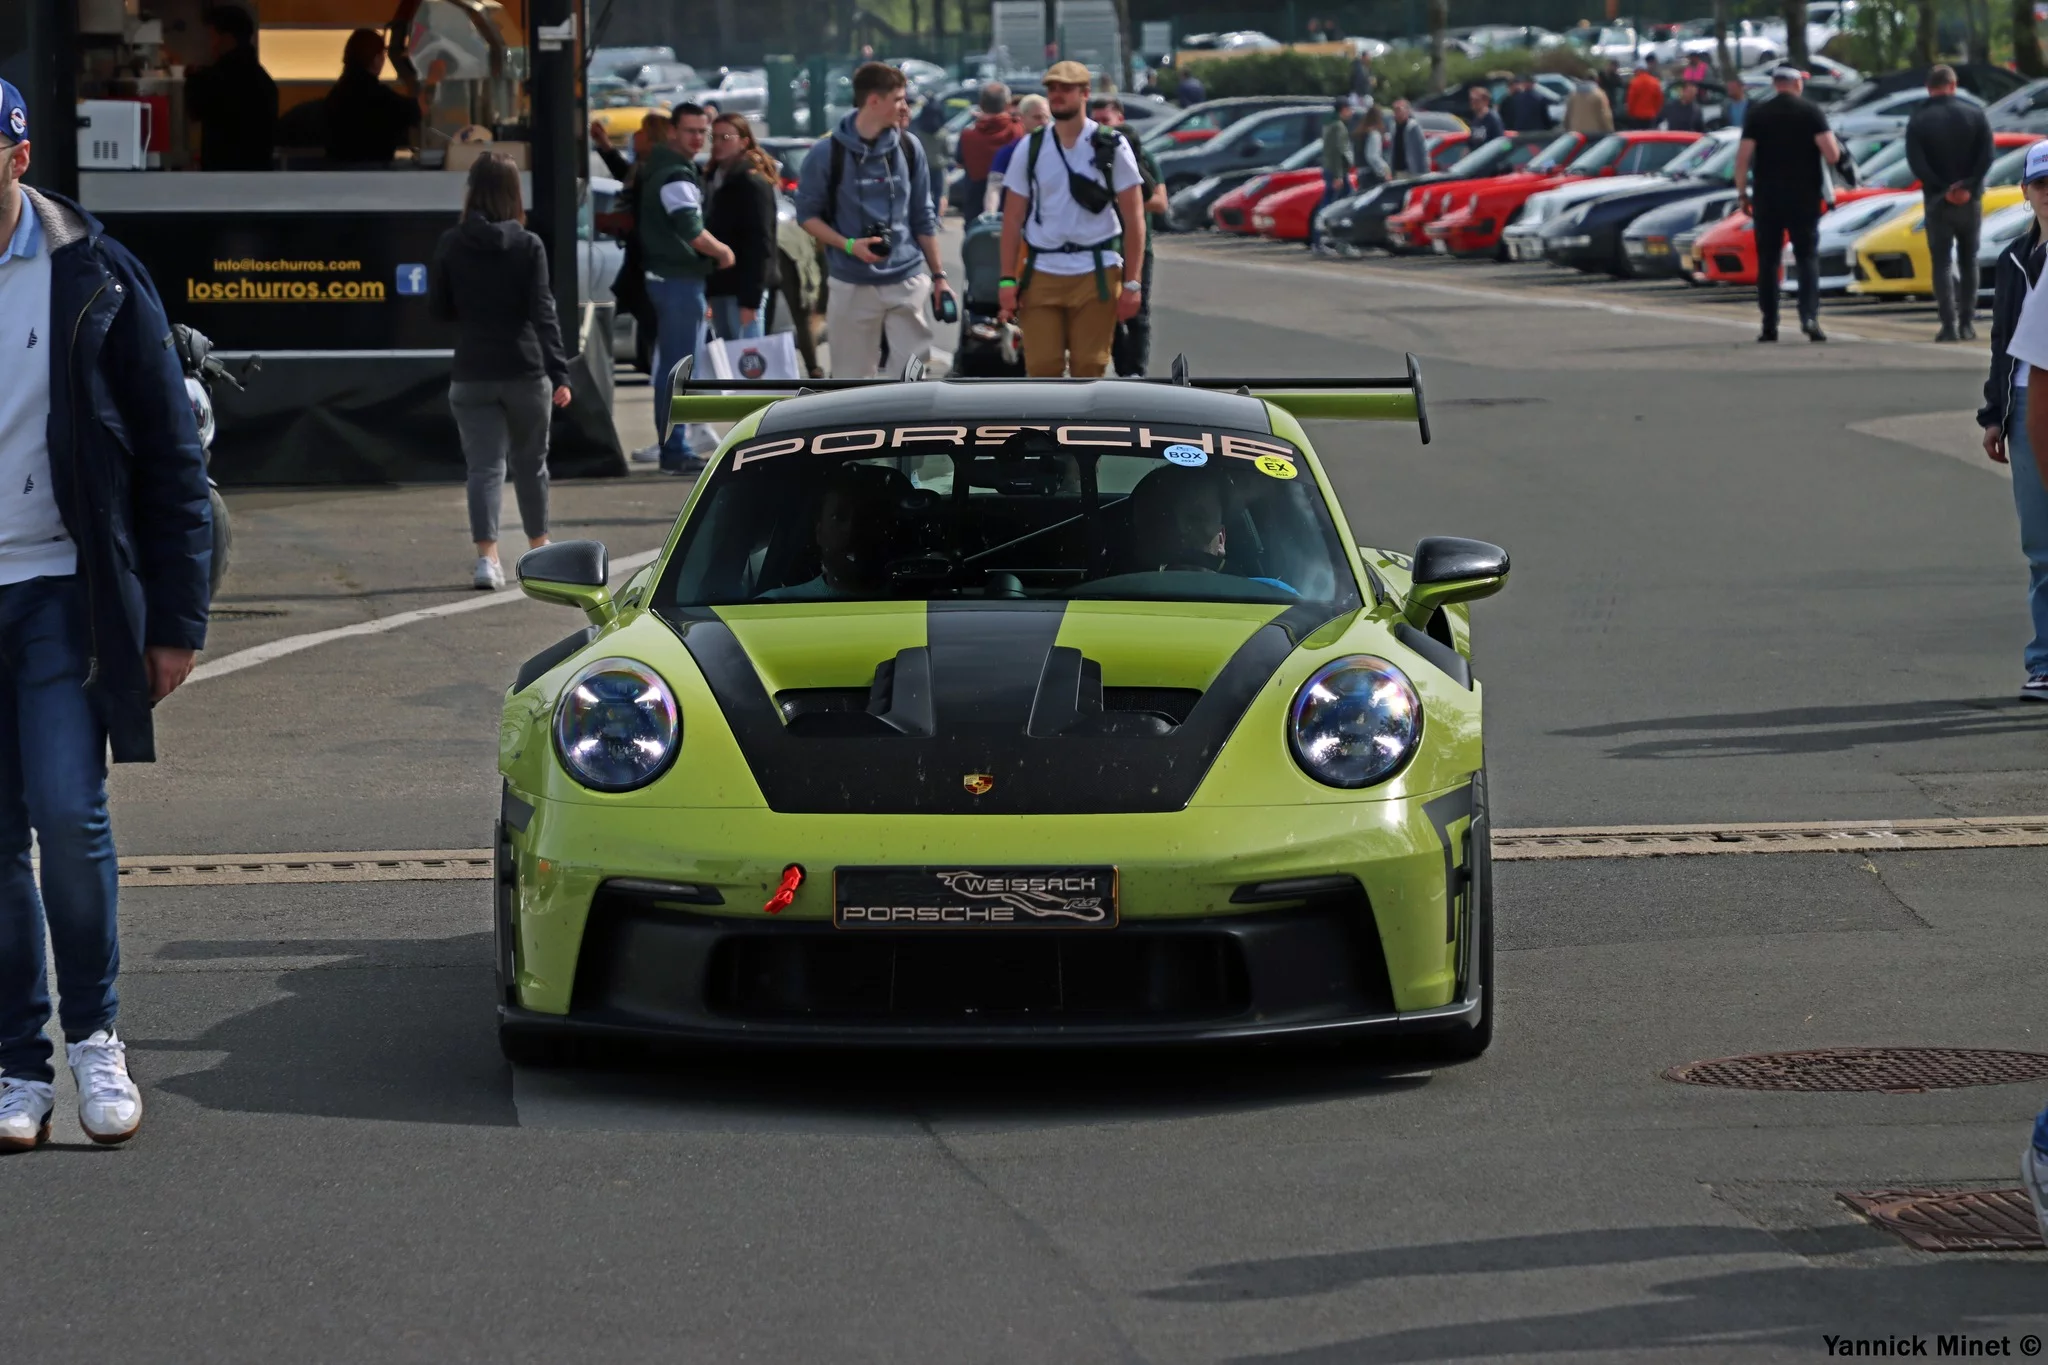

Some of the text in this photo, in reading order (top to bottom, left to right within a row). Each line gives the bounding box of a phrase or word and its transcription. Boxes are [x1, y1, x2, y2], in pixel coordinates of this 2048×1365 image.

[213, 258, 361, 272] info@loschurros.com
[187, 278, 385, 300] loschurros.com
[731, 425, 1294, 472] PORSCHE
[1169, 451, 1202, 460] BOX
[1264, 462, 1289, 472] EX
[964, 878, 1096, 892] WEISSACH
[1063, 897, 1102, 910] RS
[843, 907, 1014, 921] PORSCHE
